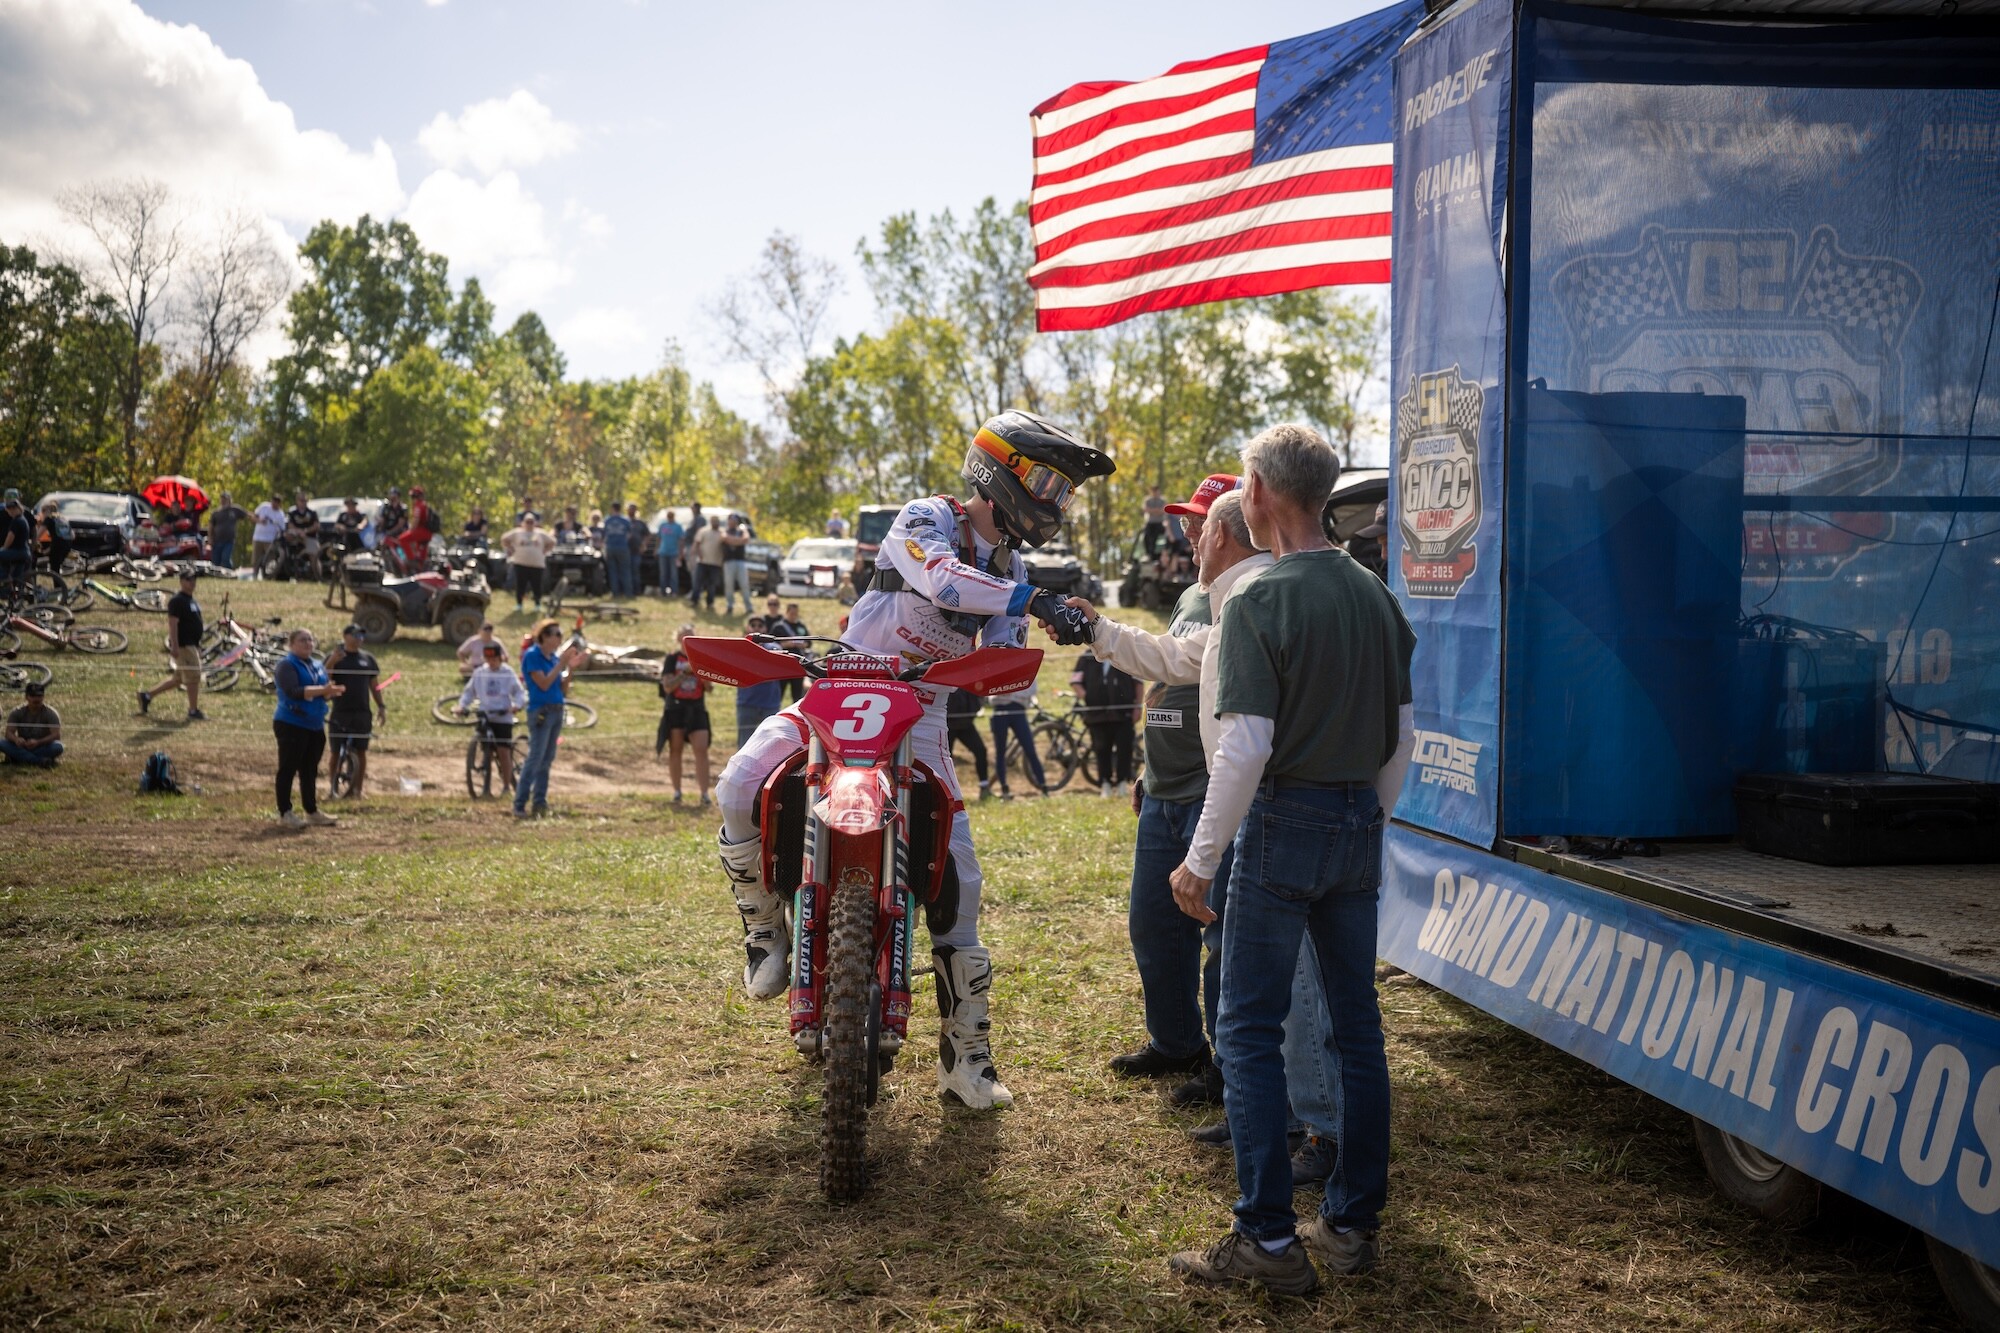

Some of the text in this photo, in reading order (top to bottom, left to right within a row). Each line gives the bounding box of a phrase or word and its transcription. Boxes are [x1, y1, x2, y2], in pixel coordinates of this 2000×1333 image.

[1404, 48, 1497, 136] PROGRESIVE
[1420, 377, 1449, 427] 50
[972, 461, 993, 484] 003
[1405, 457, 1472, 513] GNCC
[1416, 509, 1455, 530] RACING
[896, 626, 962, 660] GASG
[697, 669, 739, 686] GASGAS
[832, 662, 895, 671] RENTHAL
[988, 680, 1030, 695] GASGAS
[832, 692, 892, 741] 3
[1147, 713, 1173, 723] YEARS
[893, 893, 906, 973] DUNLP
[1417, 868, 1550, 988] GRAND
[1527, 911, 1794, 1111] NATIONAL
